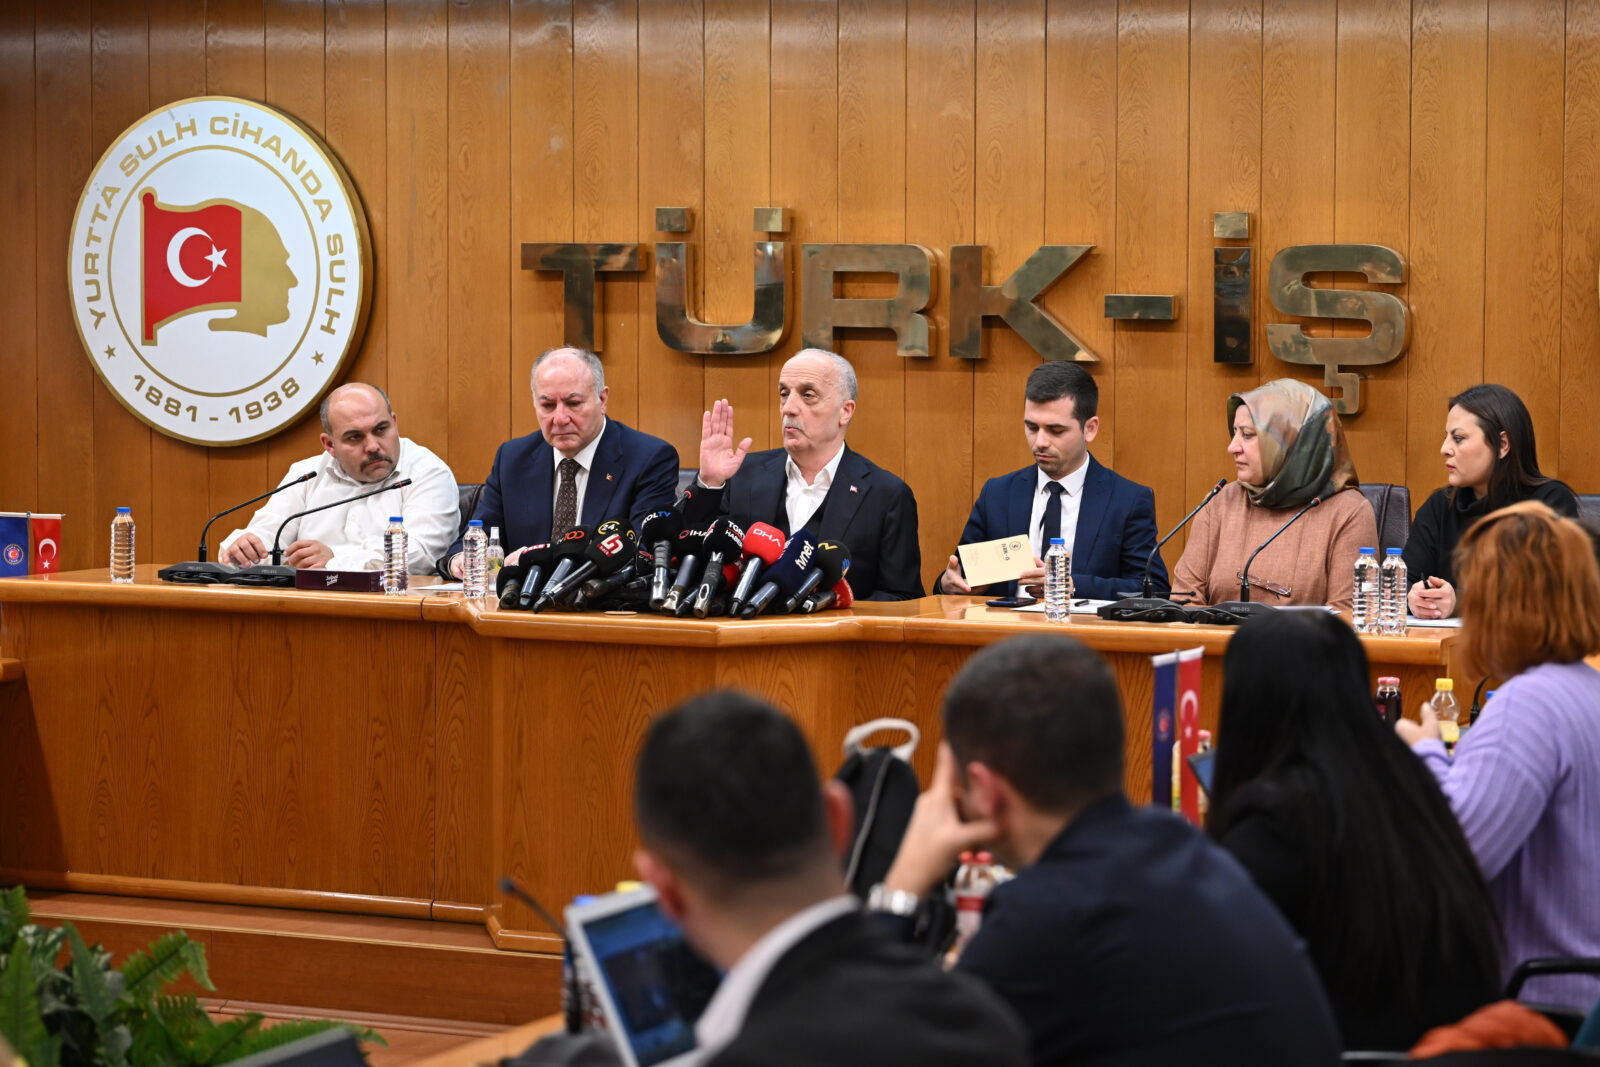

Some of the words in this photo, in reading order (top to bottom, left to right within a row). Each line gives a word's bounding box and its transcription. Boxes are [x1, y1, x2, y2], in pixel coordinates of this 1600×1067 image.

[84, 185, 121, 330] YURTTA
[119, 118, 198, 178] SULH
[209, 112, 333, 222] CİHANDA
[319, 232, 346, 335] SULH
[520, 206, 1409, 414] TÜRK-İŞ
[133, 373, 198, 422] 1881
[228, 376, 301, 424] 1938
[752, 528, 781, 547] DHA
[794, 540, 814, 571] tvnet
